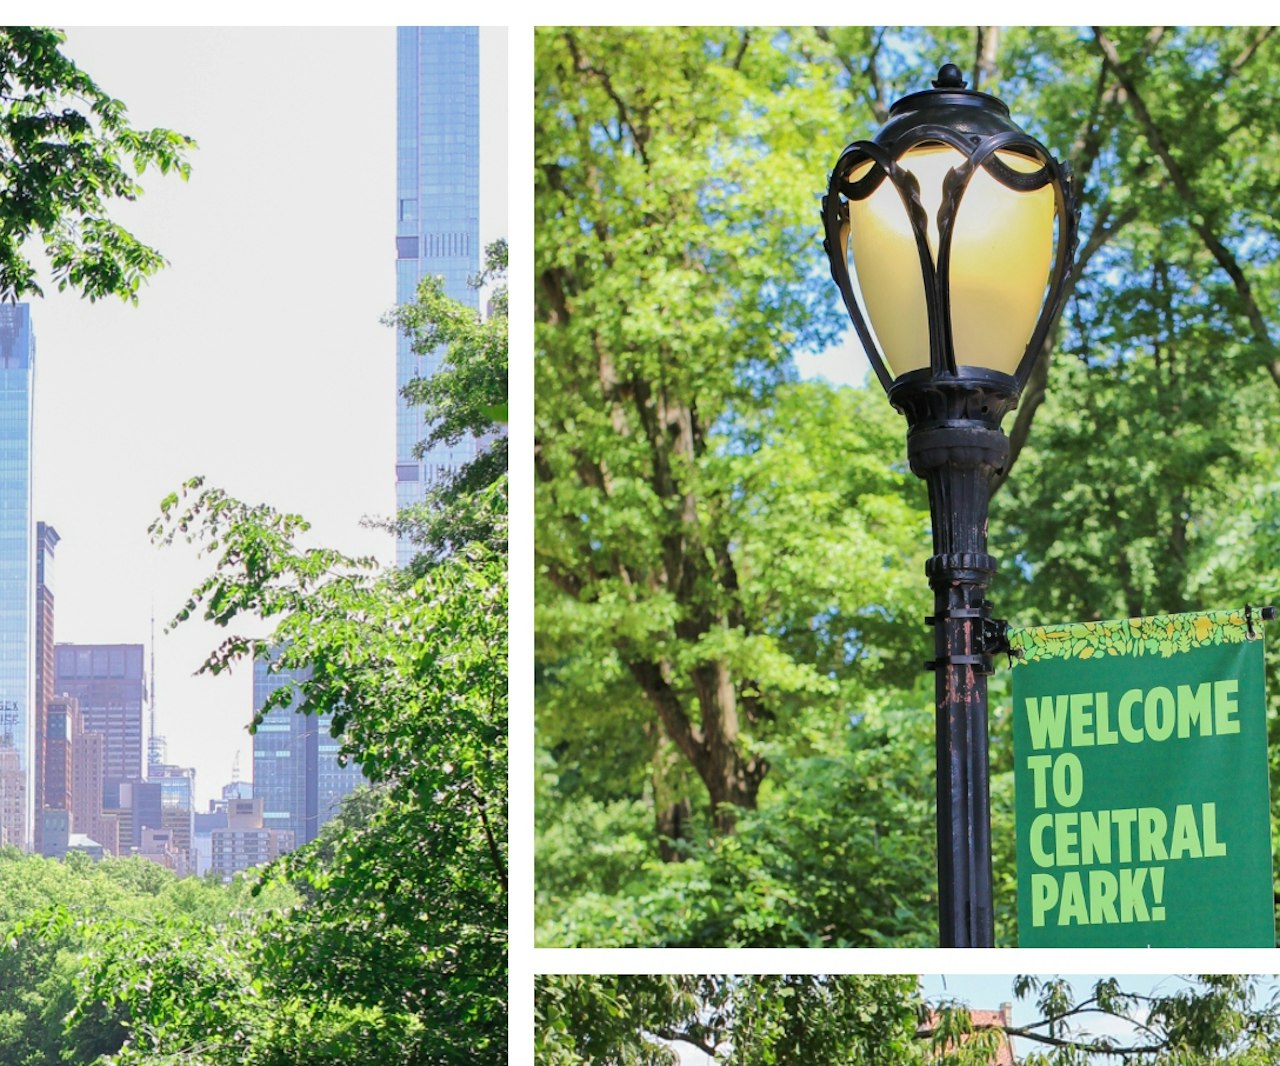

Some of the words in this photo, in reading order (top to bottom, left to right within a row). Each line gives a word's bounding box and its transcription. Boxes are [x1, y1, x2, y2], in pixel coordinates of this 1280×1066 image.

[1025, 679, 1240, 750] WELCOME
[1027, 752, 1084, 809] TO
[1029, 802, 1227, 868] CENTRAL
[1031, 866, 1166, 927] PARK!
